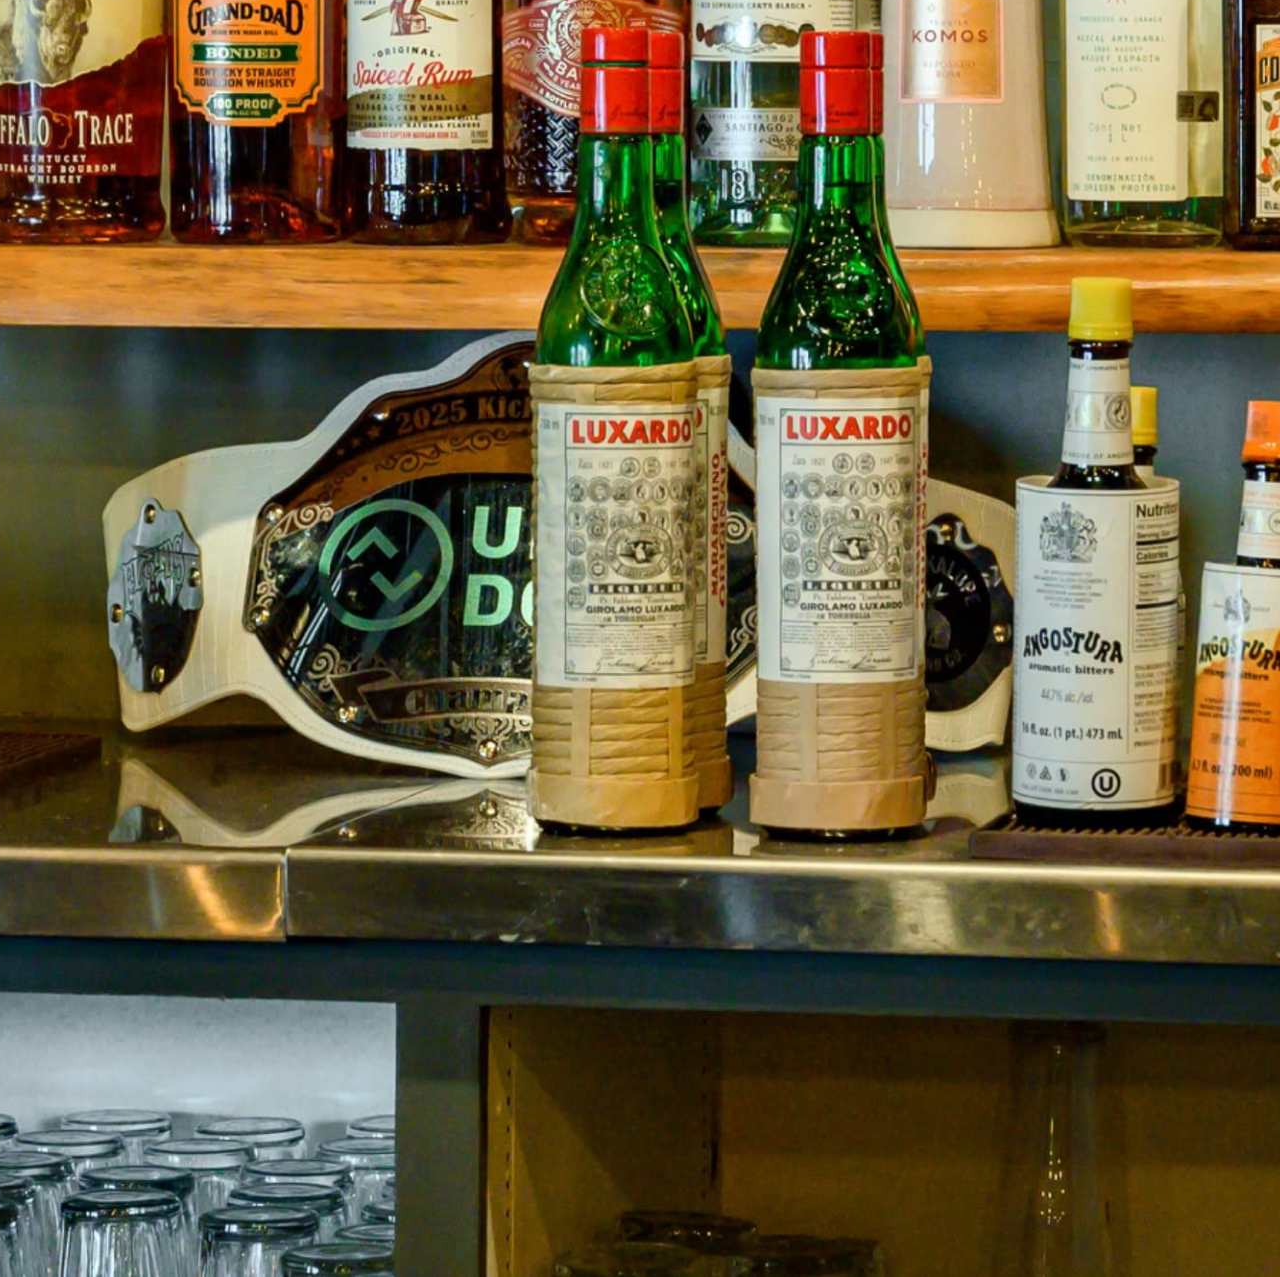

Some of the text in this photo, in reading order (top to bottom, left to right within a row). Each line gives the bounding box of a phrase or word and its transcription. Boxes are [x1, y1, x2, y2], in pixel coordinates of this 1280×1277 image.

[911, 28, 989, 45] KOMOS
[205, 46, 282, 60] BONDED
[376, 46, 436, 58] ORIGINAL
[245, 66, 297, 78] STRAIGHT
[352, 60, 473, 88] Spiced Rum
[245, 77, 297, 89] WHISKEY
[235, 98, 275, 110] PROOF
[74, 110, 134, 148] TRACE
[21, 153, 88, 164] KENTUCKY
[59, 162, 117, 173] BOURBON
[27, 173, 83, 184] WHISKEY
[395, 400, 467, 436] 2025
[570, 417, 692, 445] LUXARDO
[785, 414, 912, 441] LUXARDO
[586, 604, 643, 615] GIROLAMO
[800, 601, 903, 611] GIROLAMO LUXARDO
[1022, 626, 1124, 664] ANGOSTURA
[1028, 662, 1115, 676] aromatic bitters
[1086, 727, 1106, 739] 473
